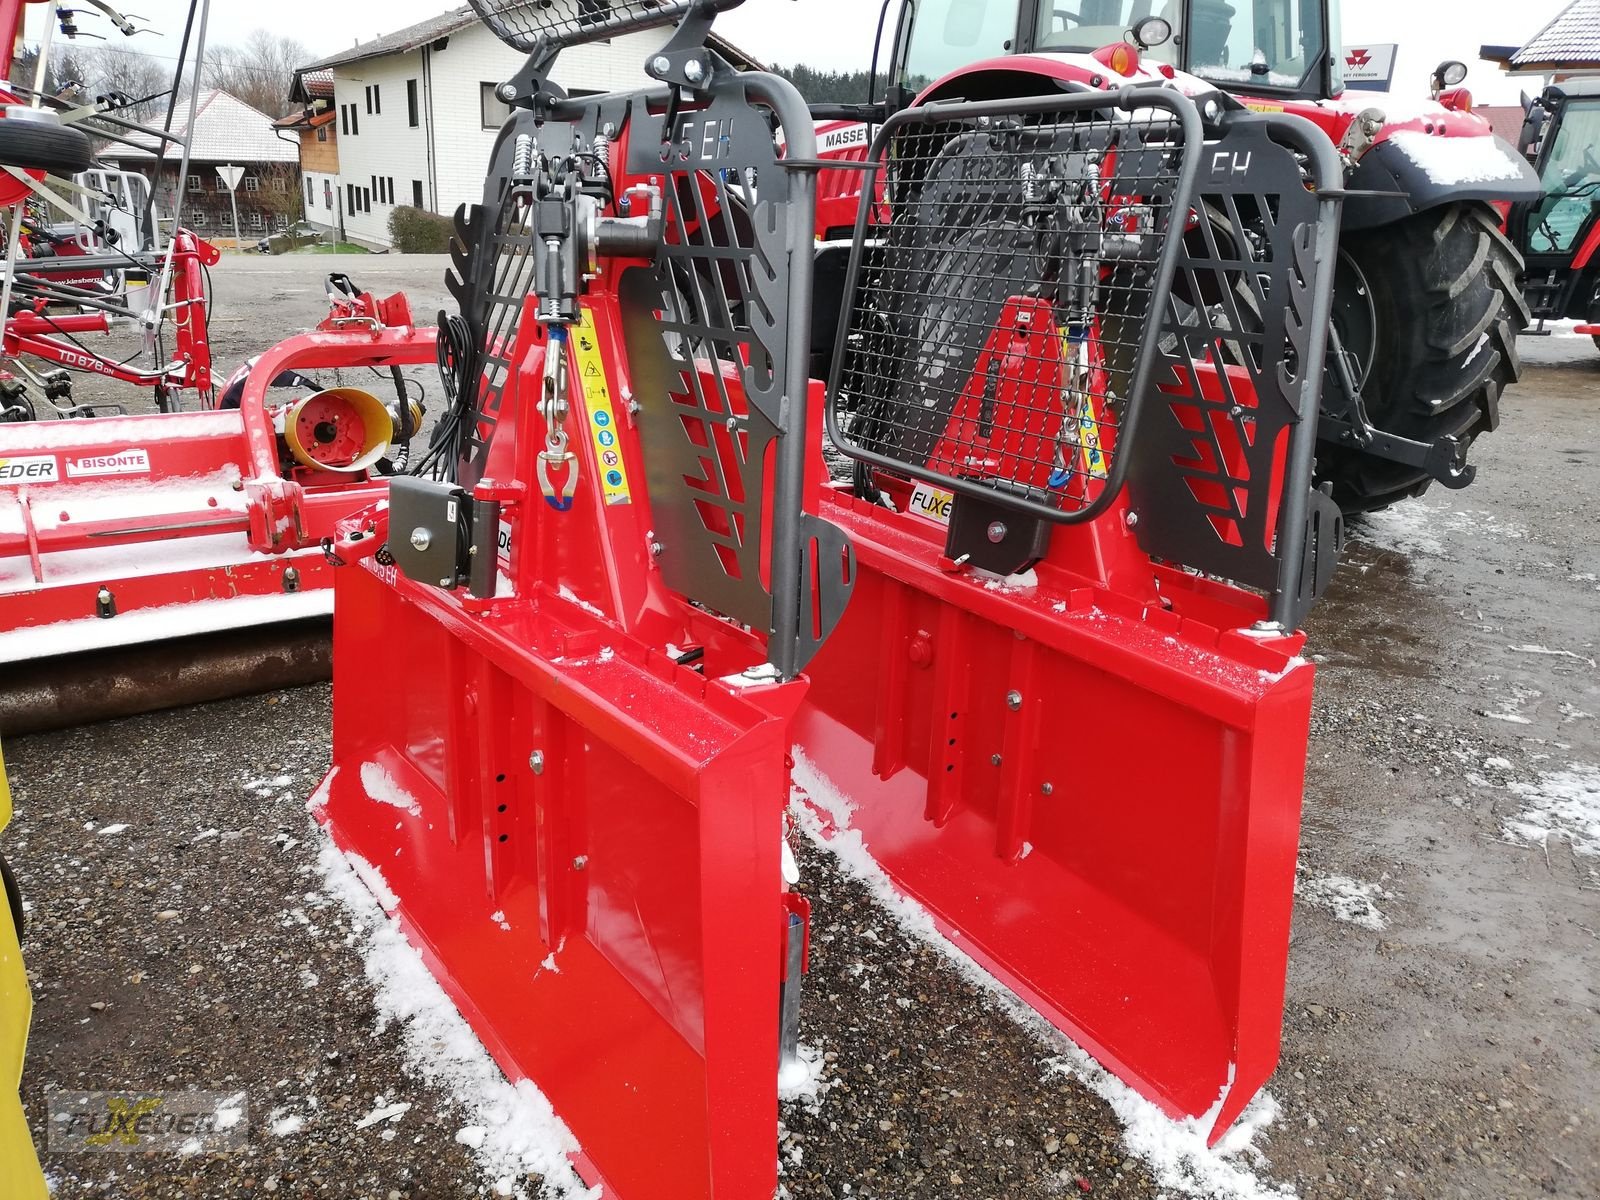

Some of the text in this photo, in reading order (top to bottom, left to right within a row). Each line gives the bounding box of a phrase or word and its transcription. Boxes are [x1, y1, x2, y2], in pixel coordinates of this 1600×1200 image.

[701, 118, 734, 160] EH
[58, 349, 76, 363] TD
[0, 462, 54, 479] EDER
[82, 455, 146, 469] BISONTE
[911, 490, 953, 518] FLIXE
